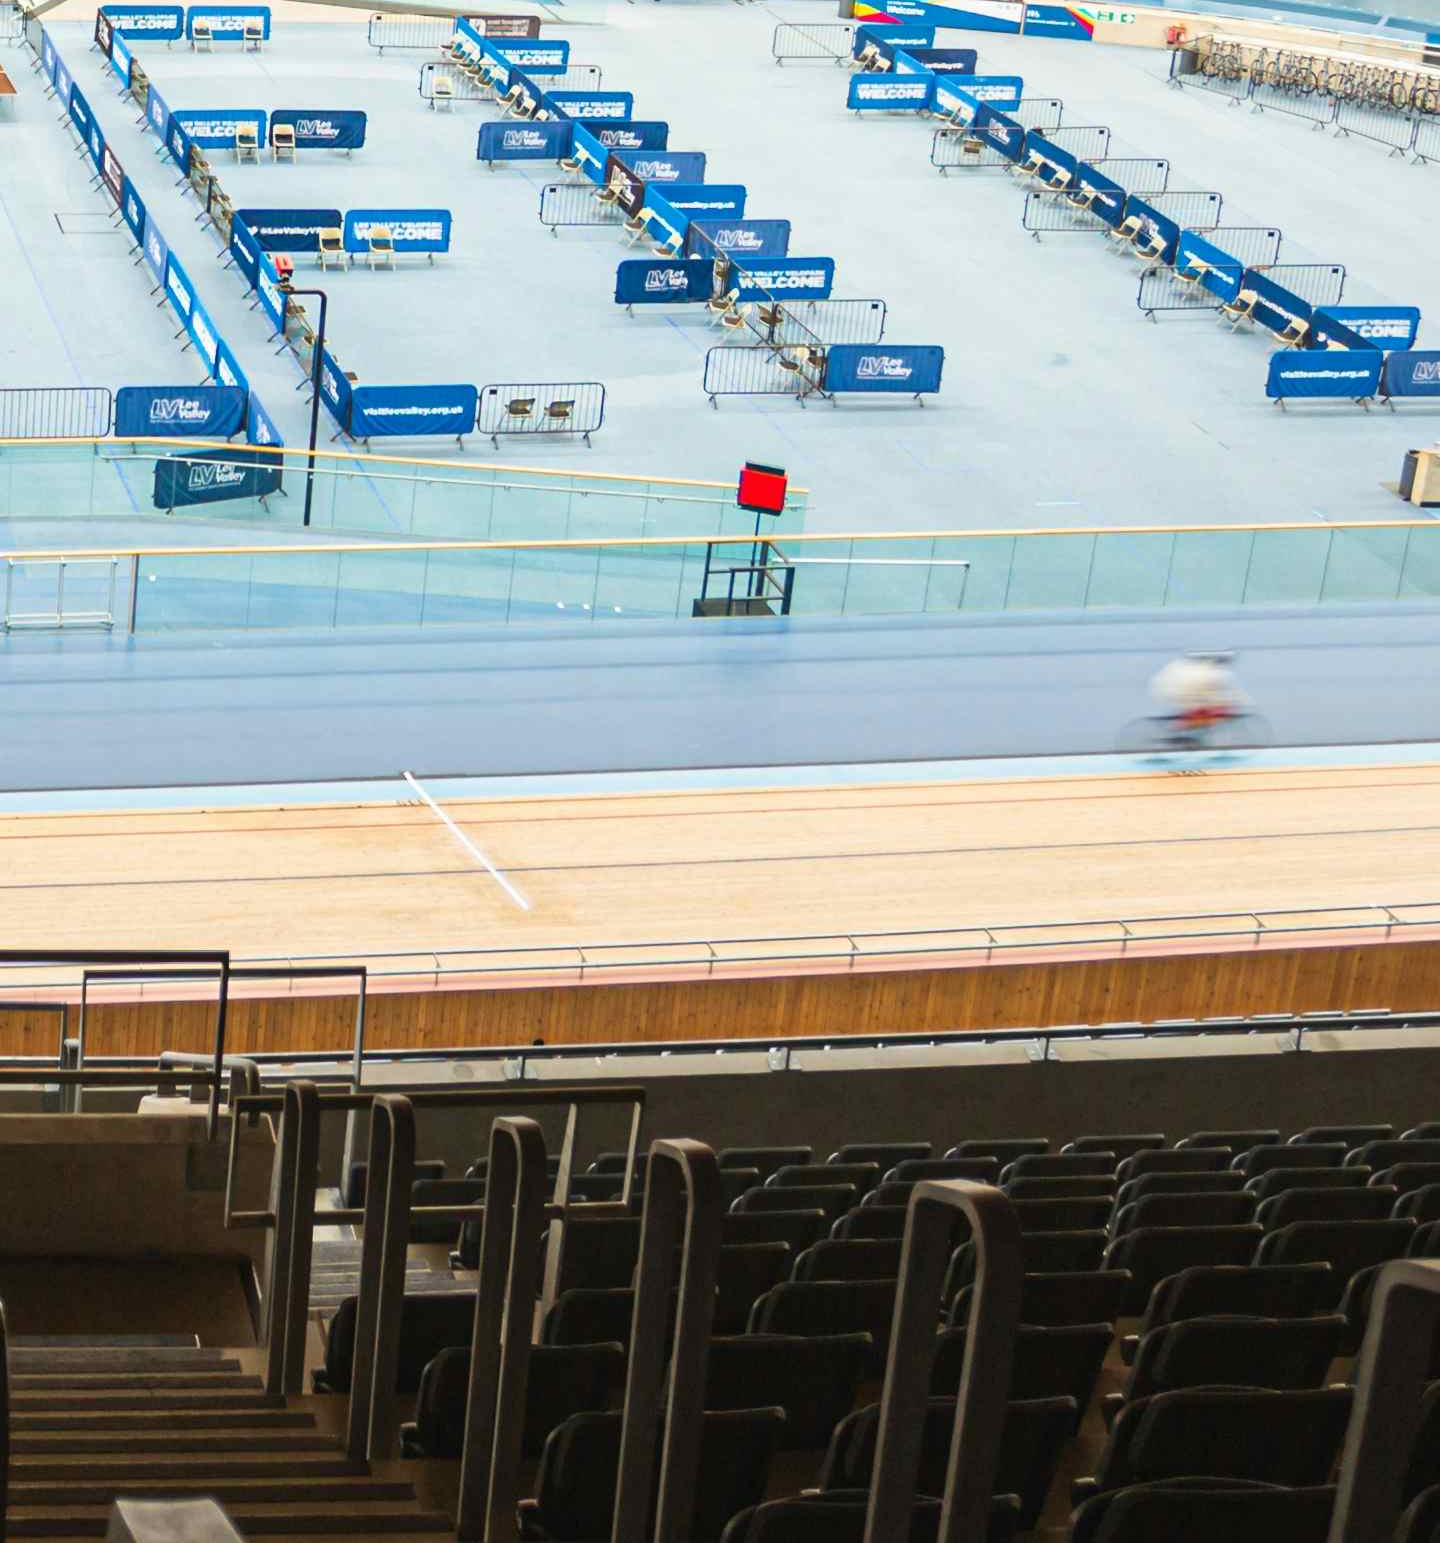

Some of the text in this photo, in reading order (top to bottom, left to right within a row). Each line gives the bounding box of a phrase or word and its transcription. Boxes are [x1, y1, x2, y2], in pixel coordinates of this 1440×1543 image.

[511, 54, 563, 65] ELCOME
[563, 106, 625, 118] ELCOME
[182, 125, 258, 138] WELCO
[354, 227, 443, 241] WCOME
[738, 276, 826, 289] WELCOME
